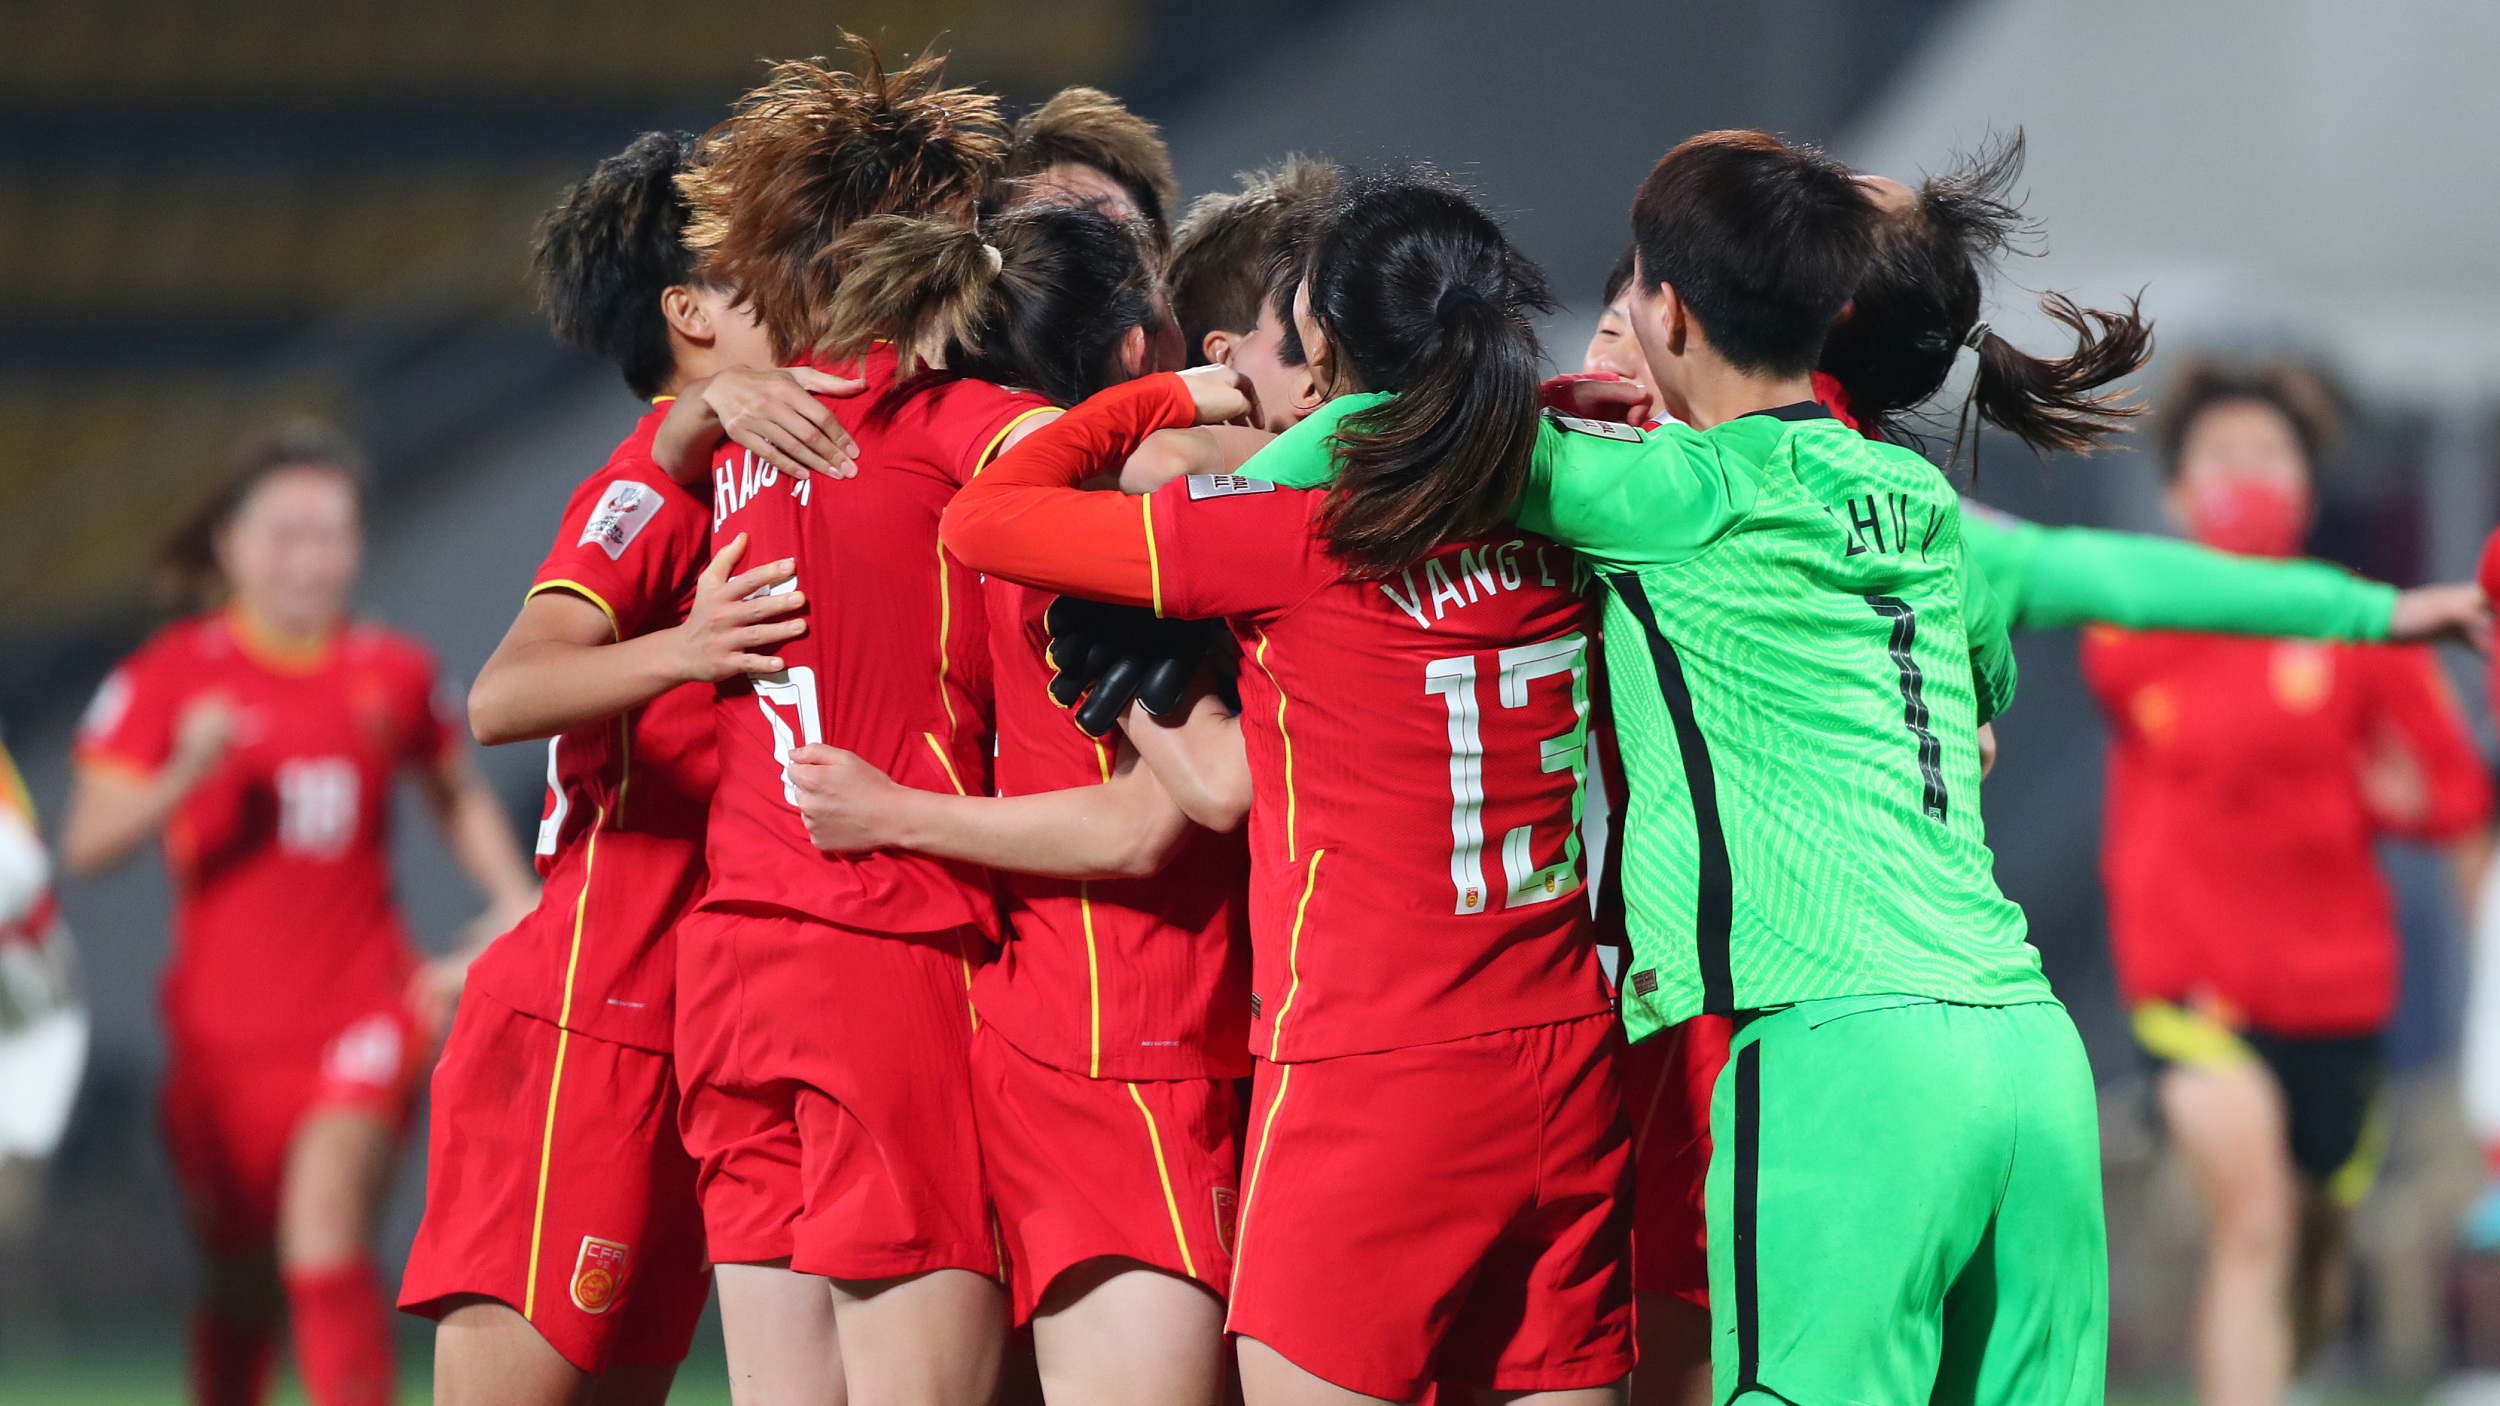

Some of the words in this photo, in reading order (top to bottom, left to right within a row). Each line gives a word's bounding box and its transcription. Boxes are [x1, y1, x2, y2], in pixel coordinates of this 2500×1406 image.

[1823, 492, 1907, 557] ZHU
[1380, 539, 1524, 629] YANG
[1864, 594, 1947, 826] 1
[1425, 631, 1590, 915] 13
[587, 1243, 623, 1264] CFA
